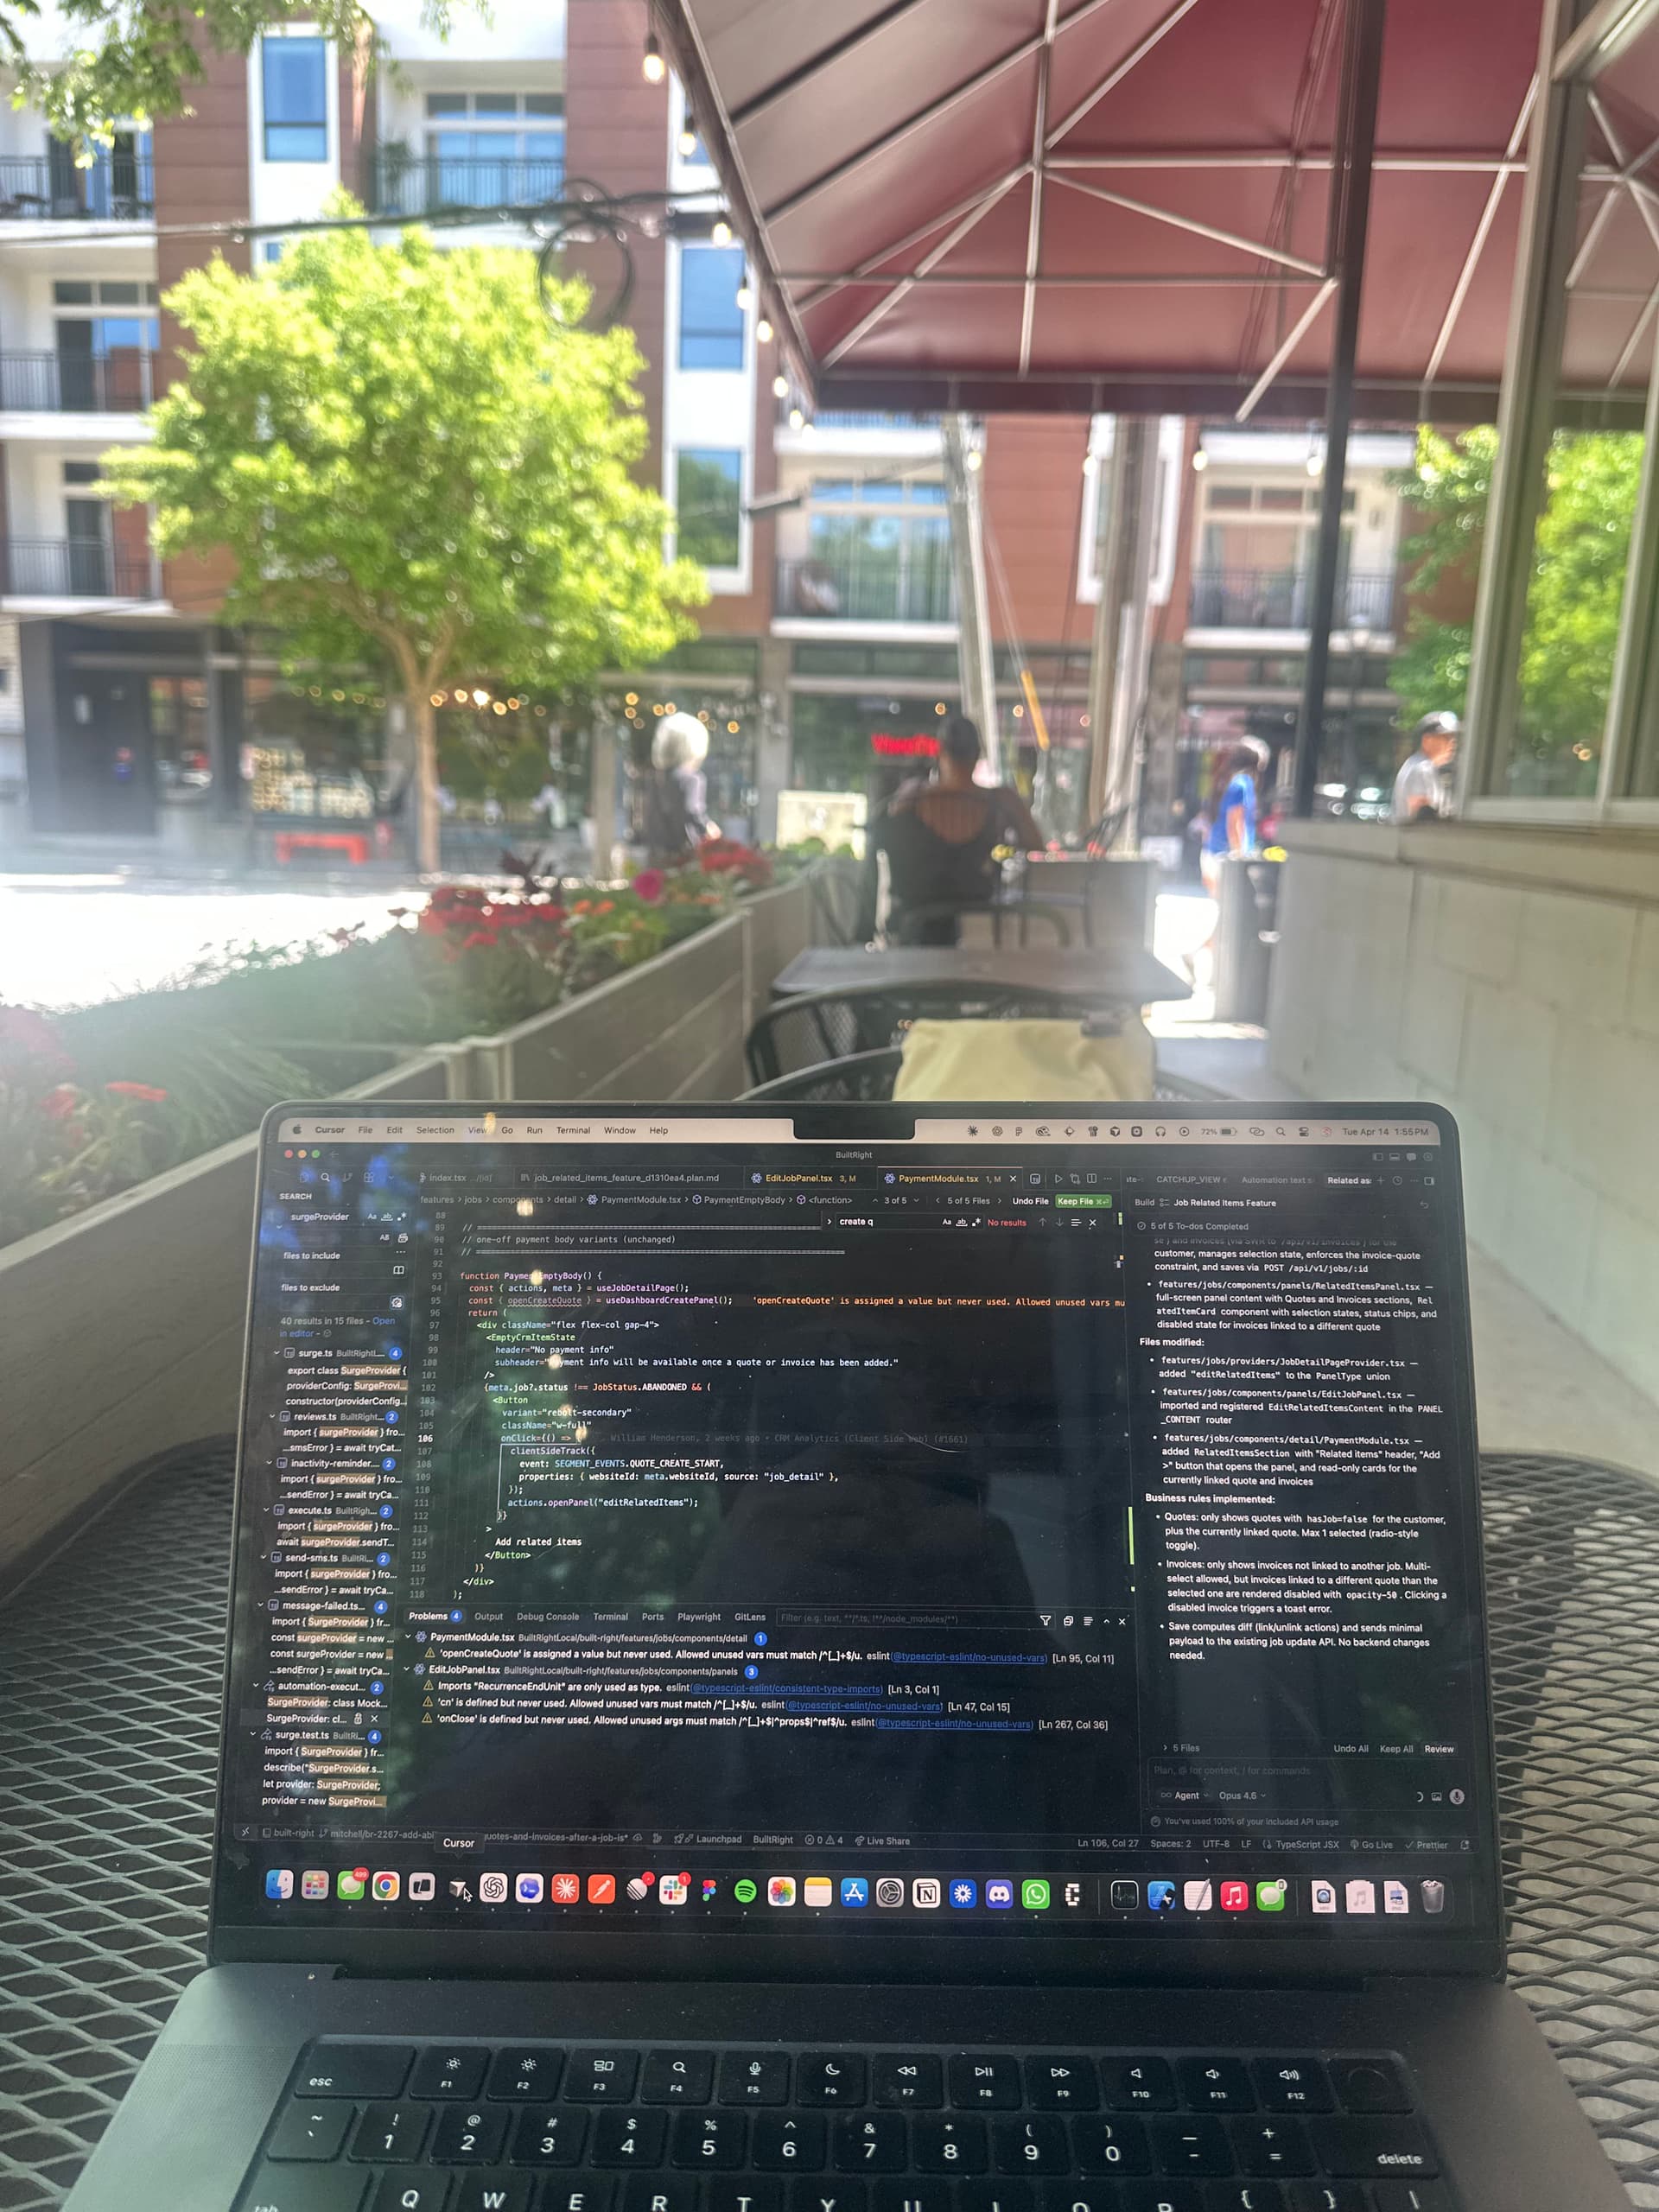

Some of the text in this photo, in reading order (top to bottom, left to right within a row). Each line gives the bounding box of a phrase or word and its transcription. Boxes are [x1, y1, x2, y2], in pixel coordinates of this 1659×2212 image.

[315, 1125, 668, 1136] Cursor File Edit Selection View Go Run Terminal Window Help
[1341, 1127, 1357, 1136] Tue
[1360, 1128, 1376, 1136] Apr
[836, 1150, 872, 1160] BuiltRight
[430, 1173, 466, 1182] index.tsx
[766, 1173, 832, 1183] EditJobPanel.tsx
[899, 1174, 978, 1184] PaymentModule.tsx
[601, 1195, 681, 1205] PaymentModule.tsx
[1013, 1197, 1049, 1205] Undo File
[1058, 1197, 1093, 1206] Keep File
[1191, 1198, 1220, 1207] Related
[1222, 1198, 1244, 1207] Items
[1246, 1198, 1276, 1207] Feature
[290, 1212, 349, 1223] surgeProvider
[1151, 1221, 1249, 1231] 5 of 5 To-dos Completed
[477, 1235, 511, 1243] one-off
[515, 1236, 550, 1245] payment
[555, 1235, 574, 1245] body
[624, 1235, 675, 1245] (unchanged)
[283, 1251, 300, 1260] files
[311, 1251, 340, 1260] include
[1154, 1249, 1421, 1262] customer, manages selection state, enforces the invoice-quote
[460, 1271, 499, 1280] function
[282, 1283, 340, 1292] files to exclude
[596, 1283, 688, 1294] useJobDetailPage();
[486, 1332, 575, 1343] <EmptyCrmItemState
[1139, 1337, 1204, 1346] Files modified:
[299, 1349, 333, 1359] surge.ts
[550, 1345, 584, 1357] payment
[287, 1365, 400, 1376] export class SurgeProvider
[294, 1412, 336, 1421] reviews.ts
[520, 1459, 549, 1468] event:
[1146, 1492, 1274, 1505] Business rules implemented:
[289, 1506, 332, 1515] execute.ts
[1165, 1512, 1446, 1525] Quotes: only shows quotes with hasJob=false for the customer,
[494, 1537, 582, 1546] Add related items
[285, 1553, 338, 1562] send-sms.ts
[484, 1550, 531, 1560] </Button>
[463, 1577, 494, 1586] </div>
[410, 1611, 448, 1620] Problems
[475, 1611, 503, 1622] Output
[517, 1611, 579, 1622] Debug Console
[593, 1611, 628, 1621] Terminal
[643, 1611, 664, 1621] Ports
[677, 1611, 721, 1623] Playwright
[734, 1611, 766, 1622] GitLens
[430, 1632, 514, 1643] PaymentModule.tsx
[524, 1649, 531, 1658] is
[532, 1648, 571, 1660] assigned
[574, 1650, 579, 1659] a
[581, 1649, 604, 1659] value
[607, 1649, 620, 1659] but
[624, 1650, 647, 1659] never
[650, 1649, 673, 1659] used.
[1170, 1650, 1205, 1660] needed.
[429, 1664, 500, 1675] EditJobPanel.tsx
[1334, 1744, 1369, 1753] Undo All
[1379, 1744, 1413, 1754] Keep All
[1424, 1745, 1453, 1753] Review
[263, 1779, 380, 1791] let provider: SurgeProvider;
[1175, 1791, 1198, 1801] Agent
[1218, 1790, 1256, 1801] Opus 4.6
[442, 1837, 474, 1848] Cursor
[696, 1834, 741, 1845] Launchpad
[868, 1836, 910, 1846] Live Share
[1078, 1838, 1139, 1849] Ln 106, Col 27
[1203, 1839, 1230, 1848] UTF-8
[1362, 1840, 1393, 1849] Go Live
[1275, 1840, 1339, 1850] TypeScript JSX
[1417, 1840, 1447, 1850] Prettier
[308, 2077, 333, 2087] esc
[516, 2081, 530, 2089] F2
[592, 2082, 606, 2091] F3
[746, 2085, 760, 2094] F5
[979, 2088, 993, 2097] F8
[385, 2133, 393, 2149] 1
[459, 2134, 475, 2151] 2
[540, 2137, 555, 2153] 3
[620, 2139, 634, 2153] 4
[701, 2139, 715, 2155] 5
[782, 2141, 797, 2157] 6
[863, 2143, 876, 2158] 7
[943, 2143, 958, 2159] 8
[1024, 2144, 1039, 2160] 9
[1105, 2145, 1120, 2162] 0
[1376, 2153, 1423, 2164] delete
[400, 2190, 419, 2209] Q
[483, 2191, 505, 2209] W
[568, 2193, 584, 2211] E
